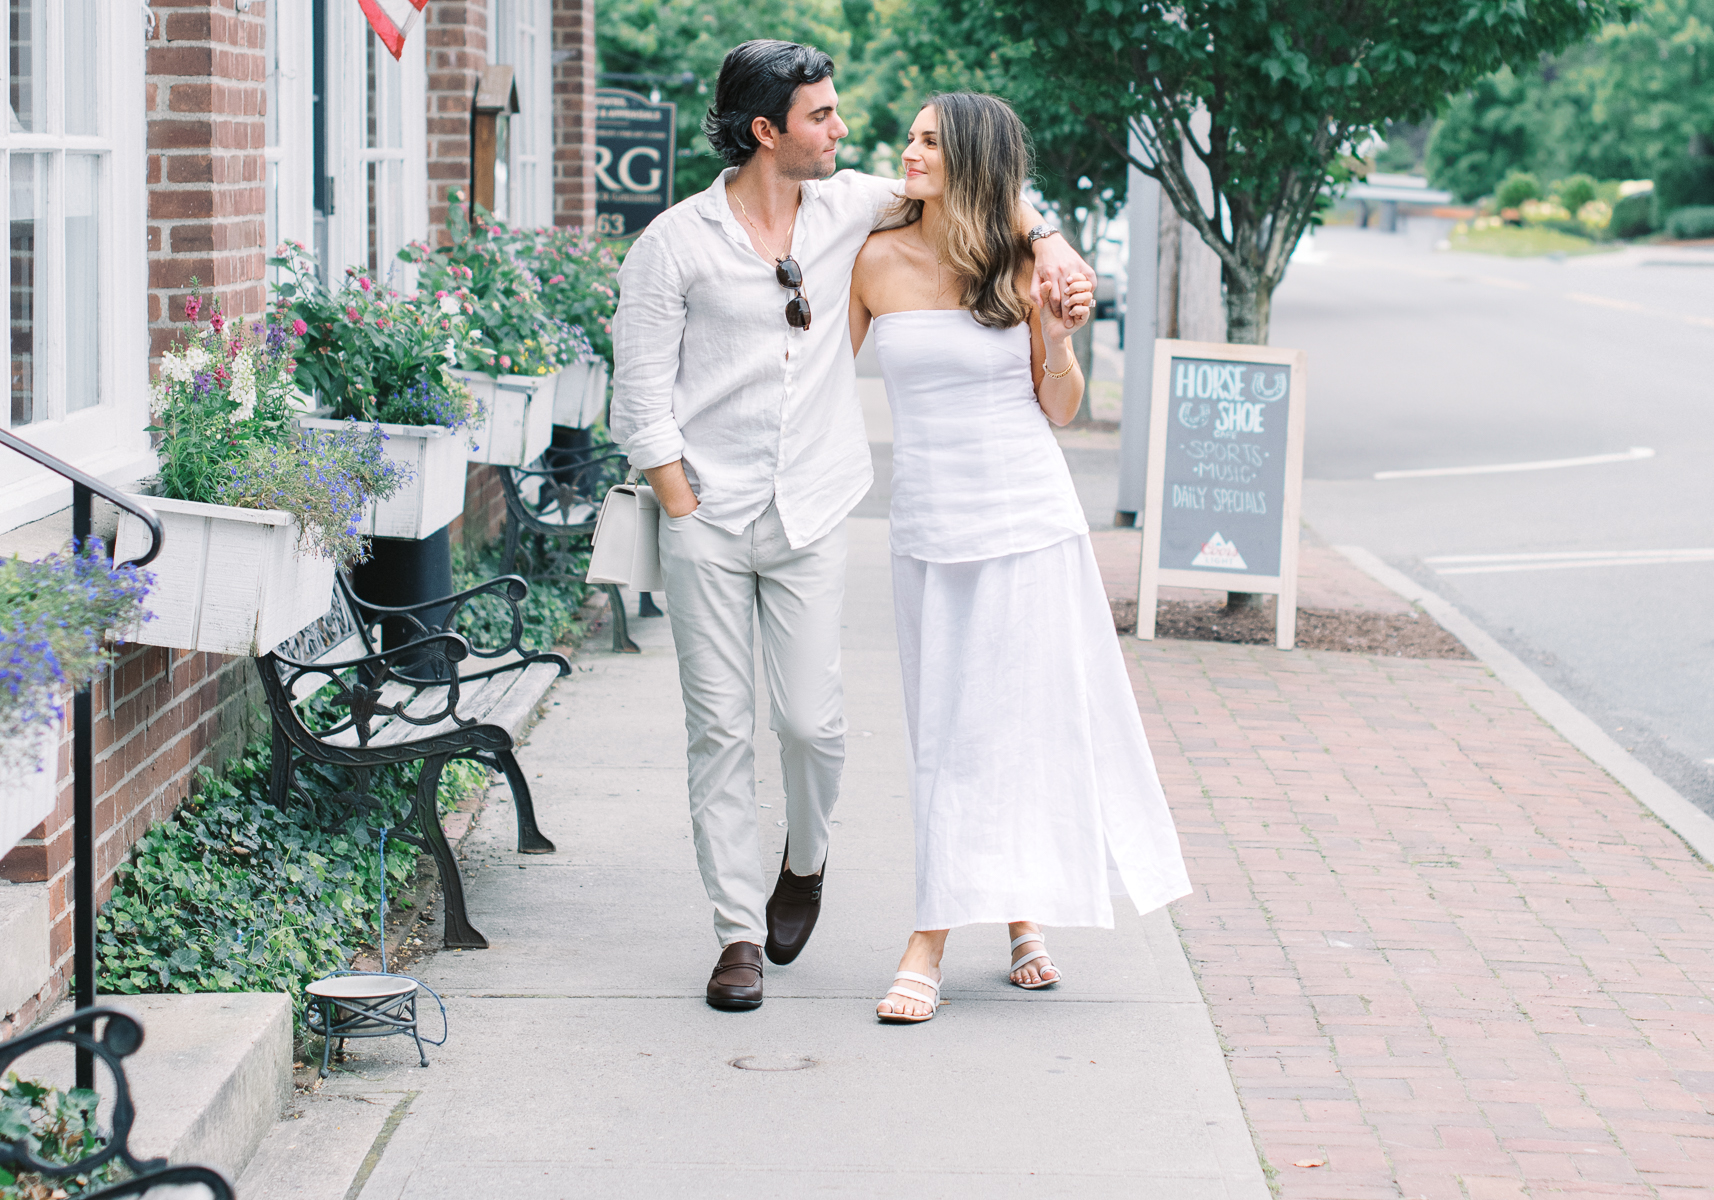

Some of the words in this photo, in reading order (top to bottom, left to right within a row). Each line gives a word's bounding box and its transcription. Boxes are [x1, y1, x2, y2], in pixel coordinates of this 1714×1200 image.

[595, 145, 662, 193] RG
[596, 213, 625, 235] 63
[1175, 363, 1247, 401] HORSE
[1215, 400, 1266, 433] SHOE
[1198, 461, 1251, 484] MUSIC
[1213, 488, 1267, 514] SPECIALS
